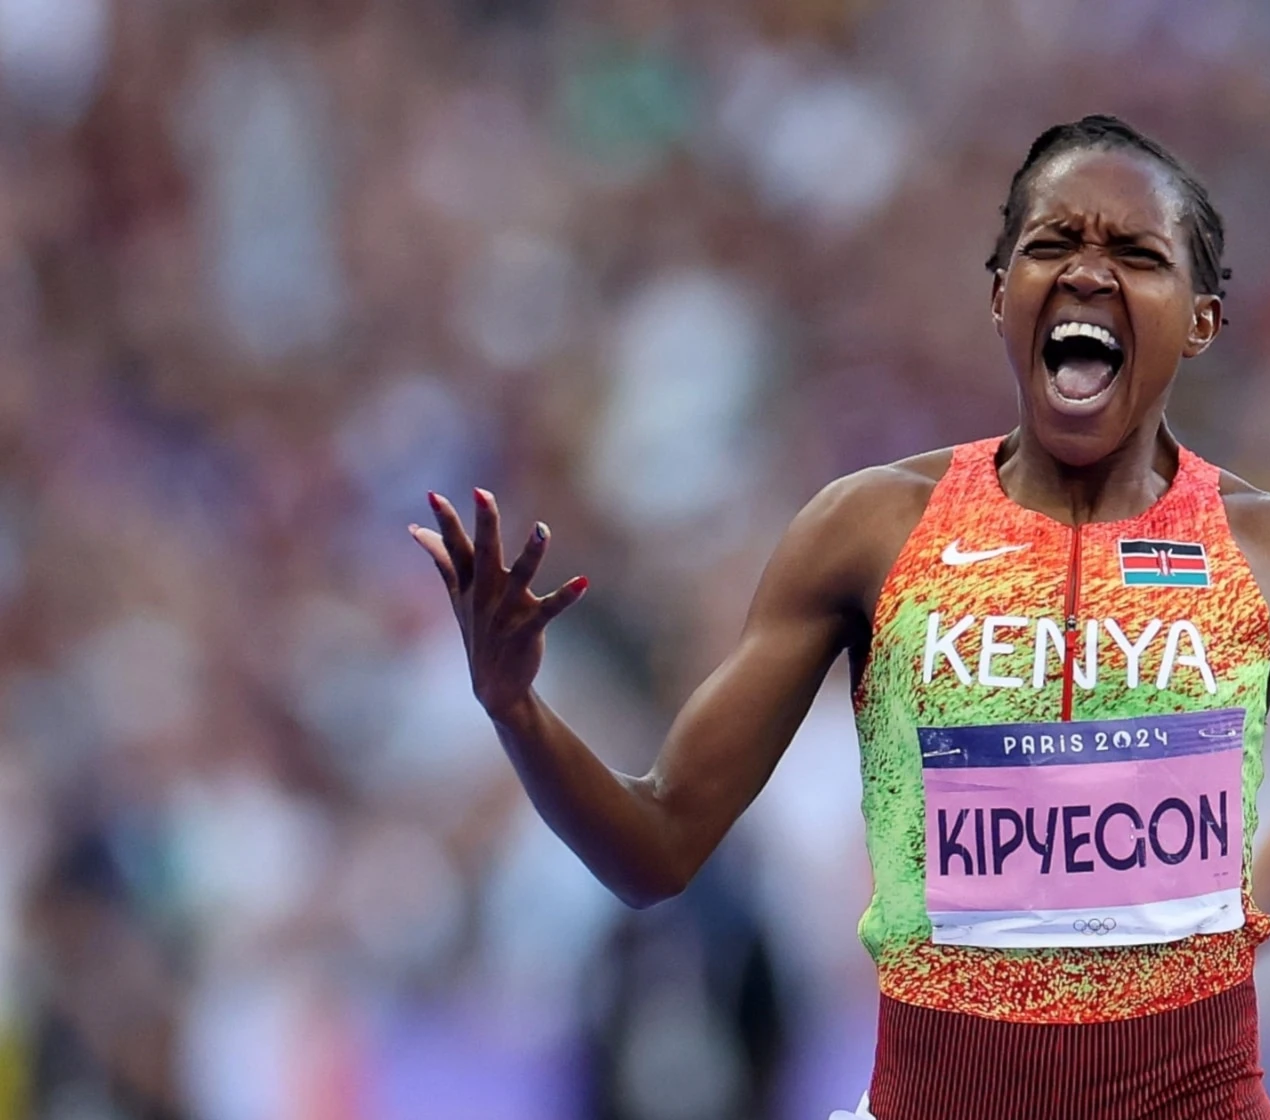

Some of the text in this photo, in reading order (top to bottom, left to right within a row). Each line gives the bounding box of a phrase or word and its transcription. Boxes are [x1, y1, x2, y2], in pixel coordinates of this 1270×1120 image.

[922, 611, 1218, 694] KENYA
[1094, 728, 1169, 751] 2024
[937, 790, 1229, 876] KIPYEGON
